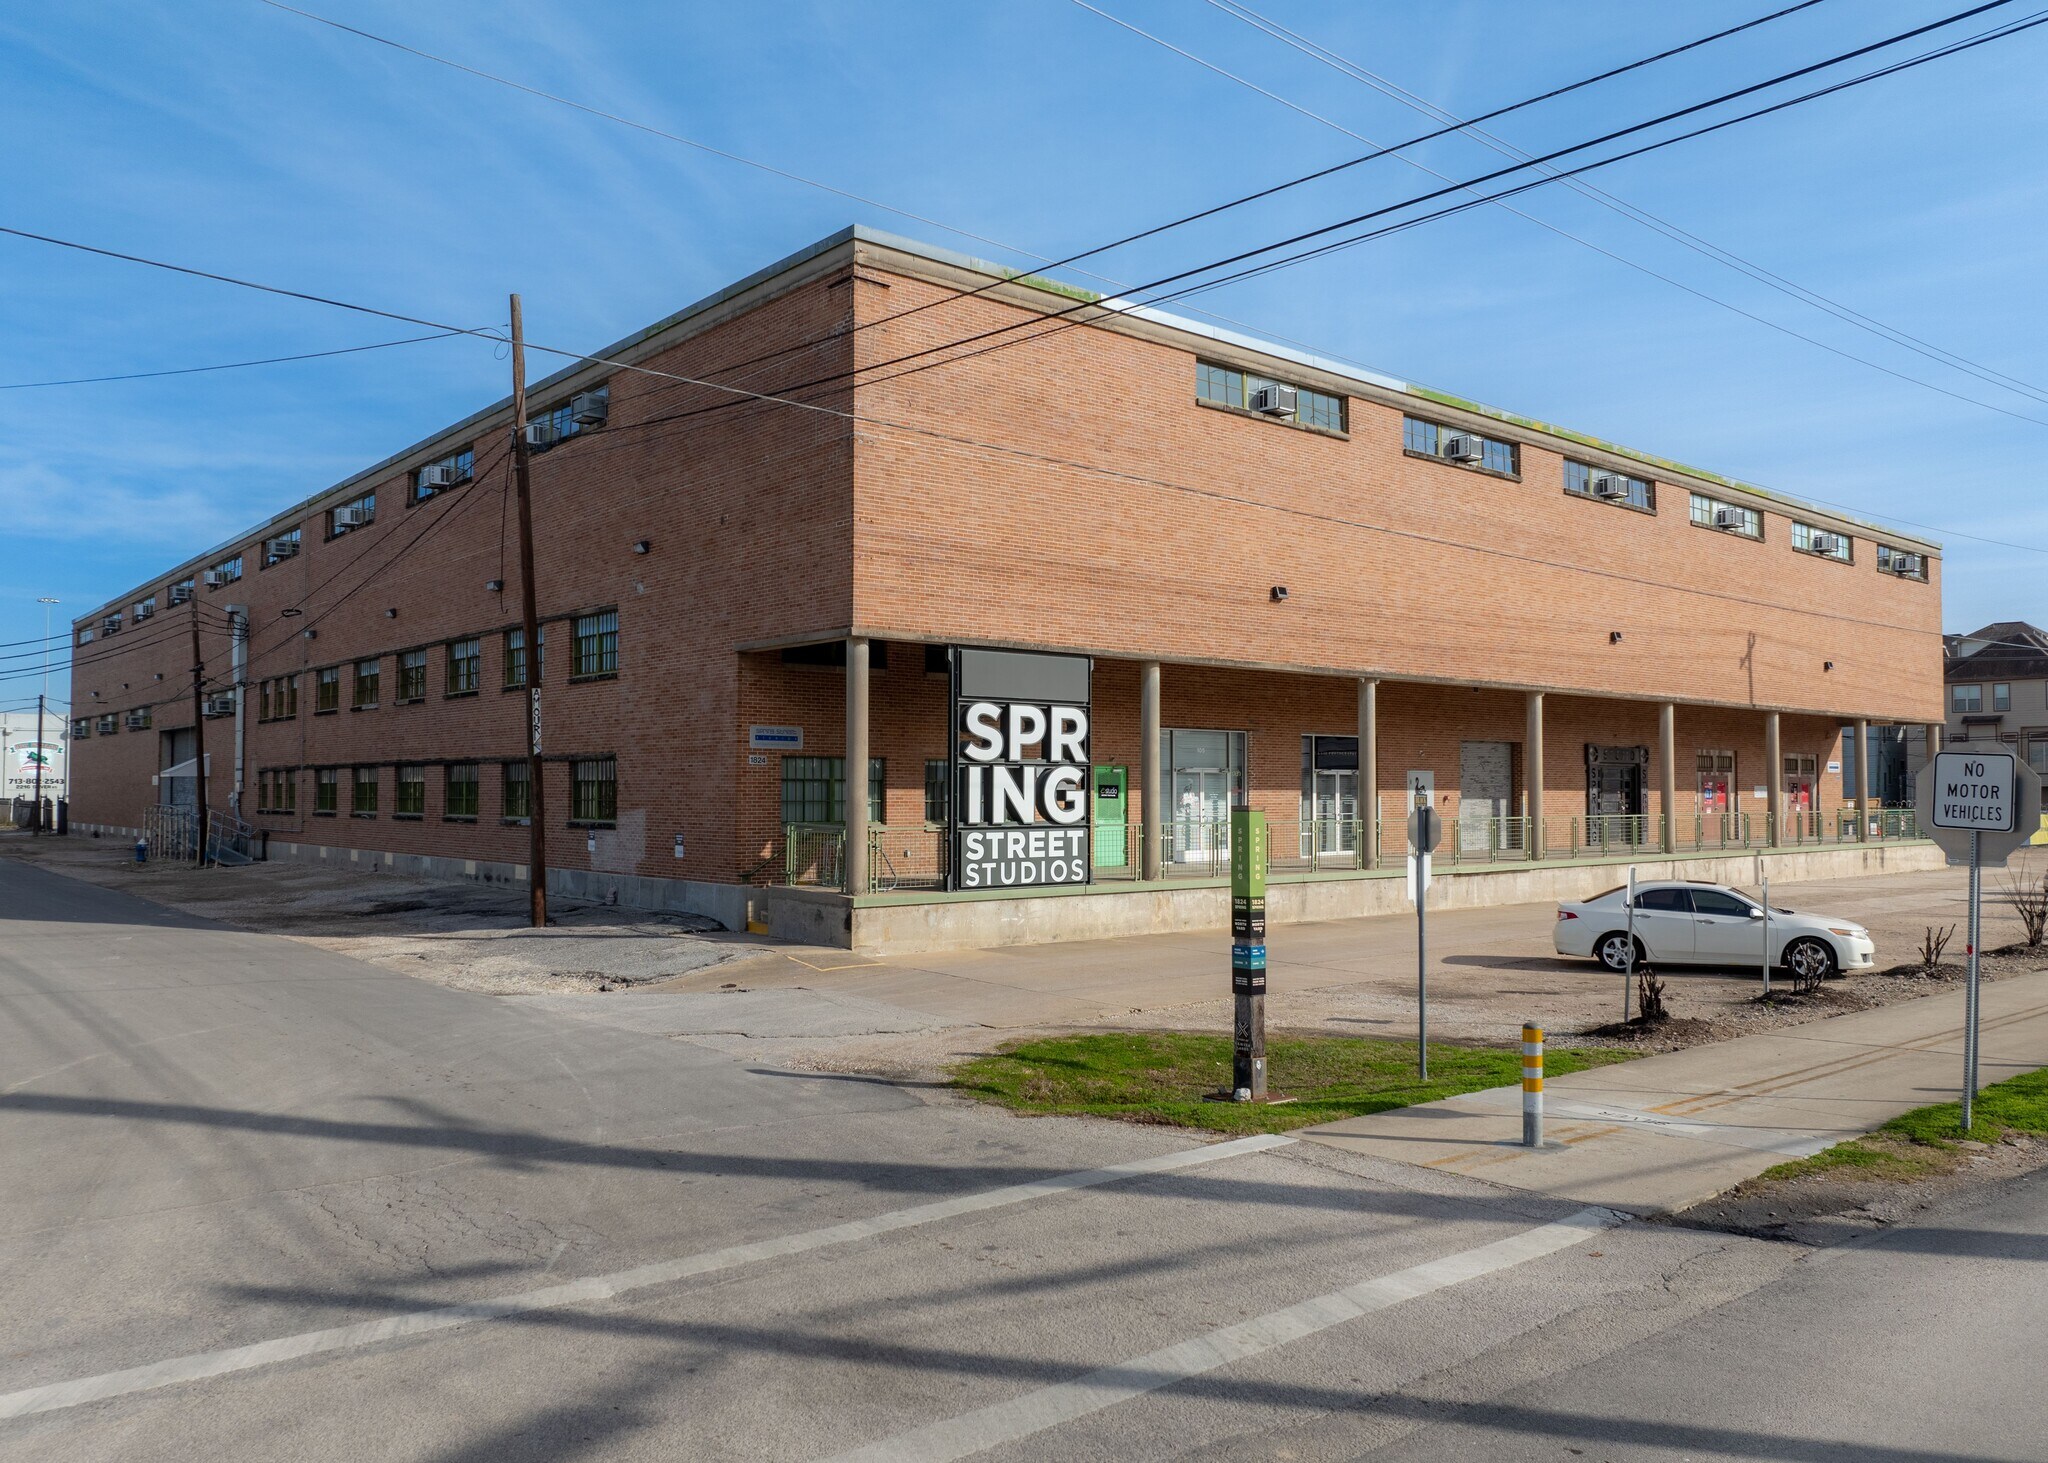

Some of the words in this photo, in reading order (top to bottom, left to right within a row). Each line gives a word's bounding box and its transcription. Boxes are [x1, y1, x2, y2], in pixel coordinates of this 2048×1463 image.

[964, 702, 1089, 762] SPR
[1964, 763, 1985, 777] NO
[968, 765, 1085, 825] ING
[1947, 783, 2000, 799] MOTOR
[1944, 804, 2002, 821] VEHICLES
[965, 830, 1084, 861] STREET
[965, 859, 1084, 887] STUDIOS
